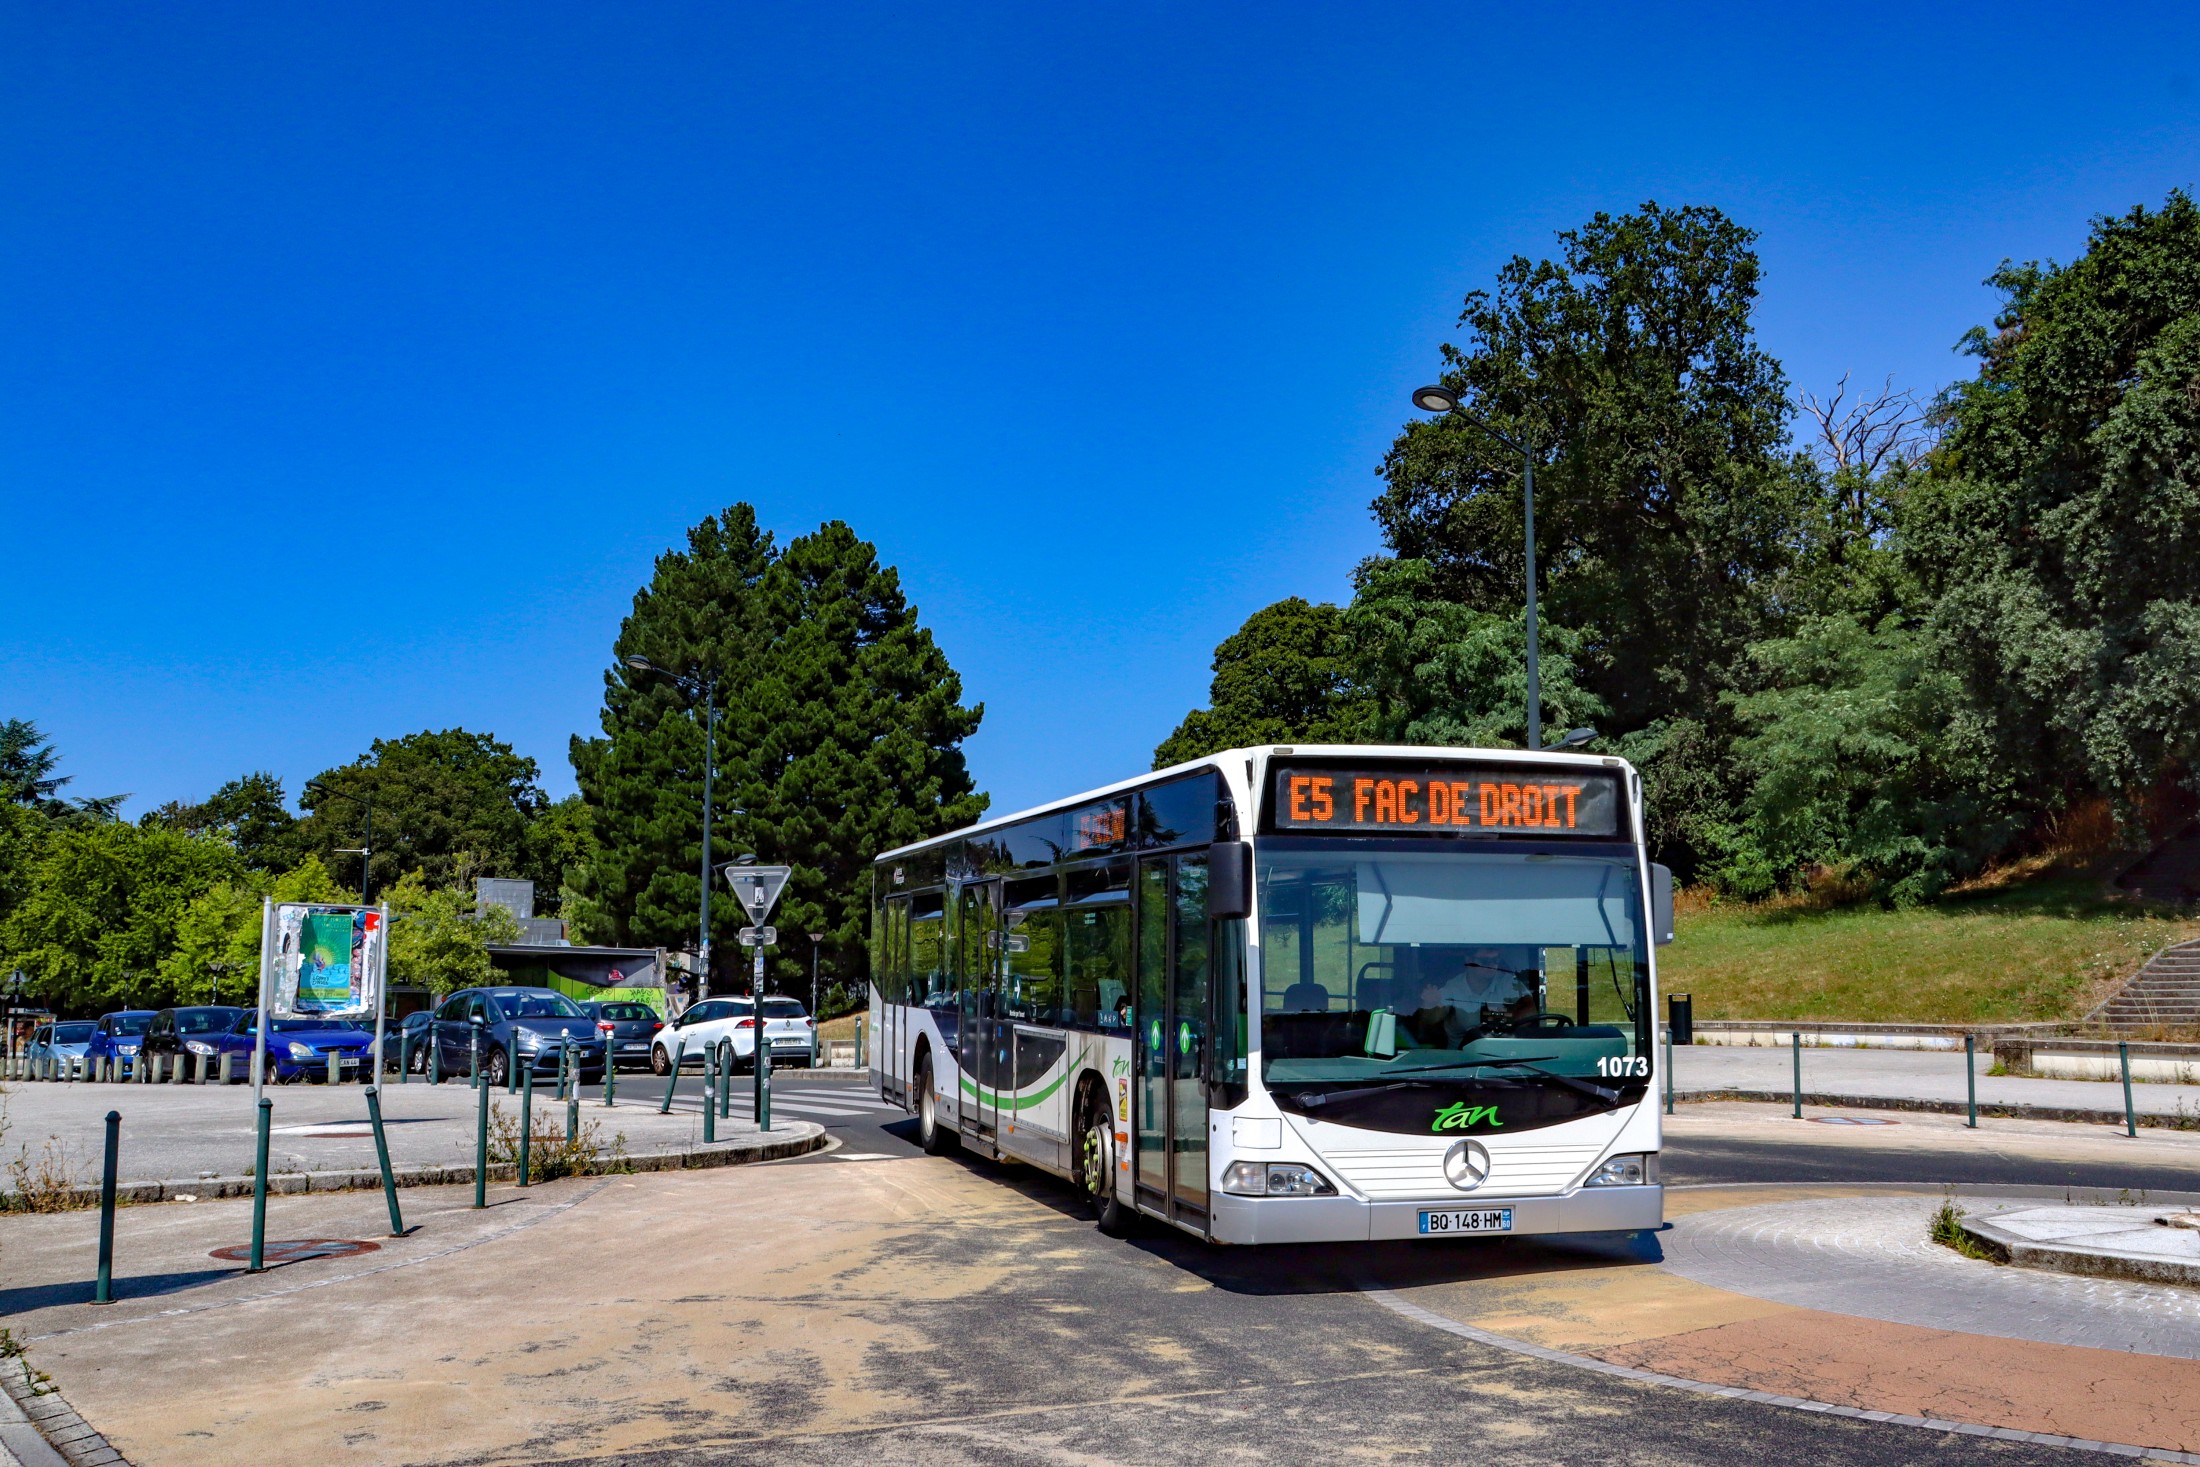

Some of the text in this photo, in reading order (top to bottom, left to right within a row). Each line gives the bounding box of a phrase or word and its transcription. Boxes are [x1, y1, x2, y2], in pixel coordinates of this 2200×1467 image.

[1290, 776, 1581, 828] E5 FAC DE DROIT
[1597, 1056, 1649, 1077] 1073
[1431, 1101, 1504, 1131] tan
